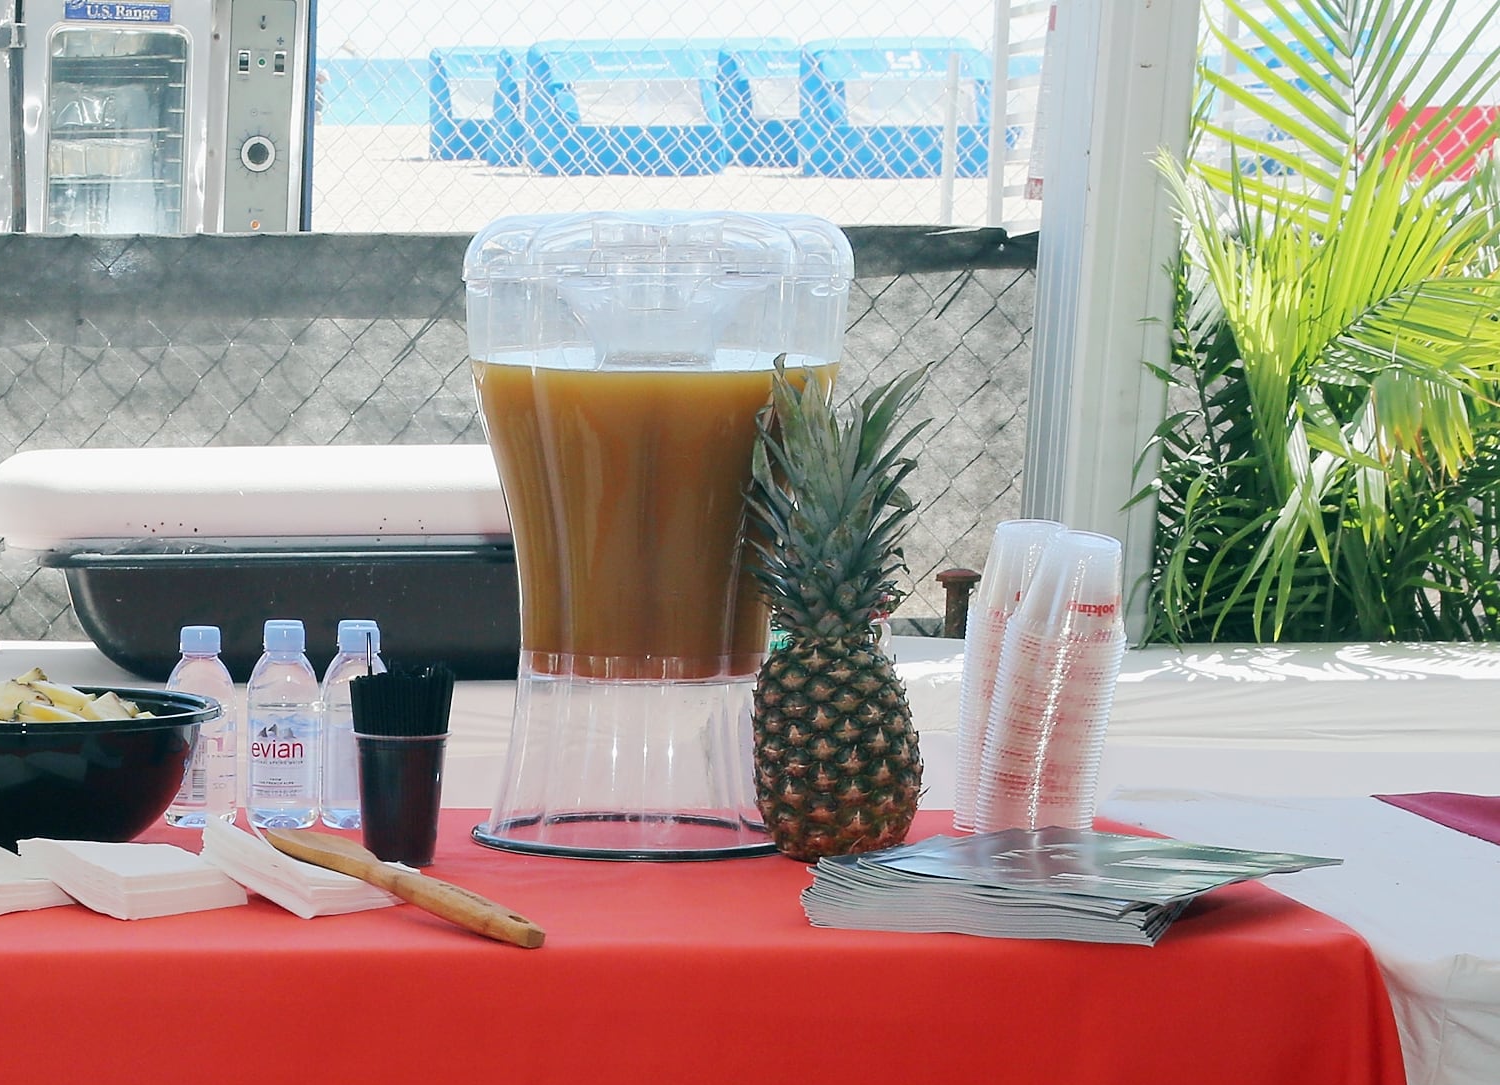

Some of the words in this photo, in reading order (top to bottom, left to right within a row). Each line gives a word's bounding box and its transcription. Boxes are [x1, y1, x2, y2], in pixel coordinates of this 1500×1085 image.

[86, 4, 113, 18] U.S.
[115, 4, 158, 20] Range
[251, 739, 304, 759] evian
